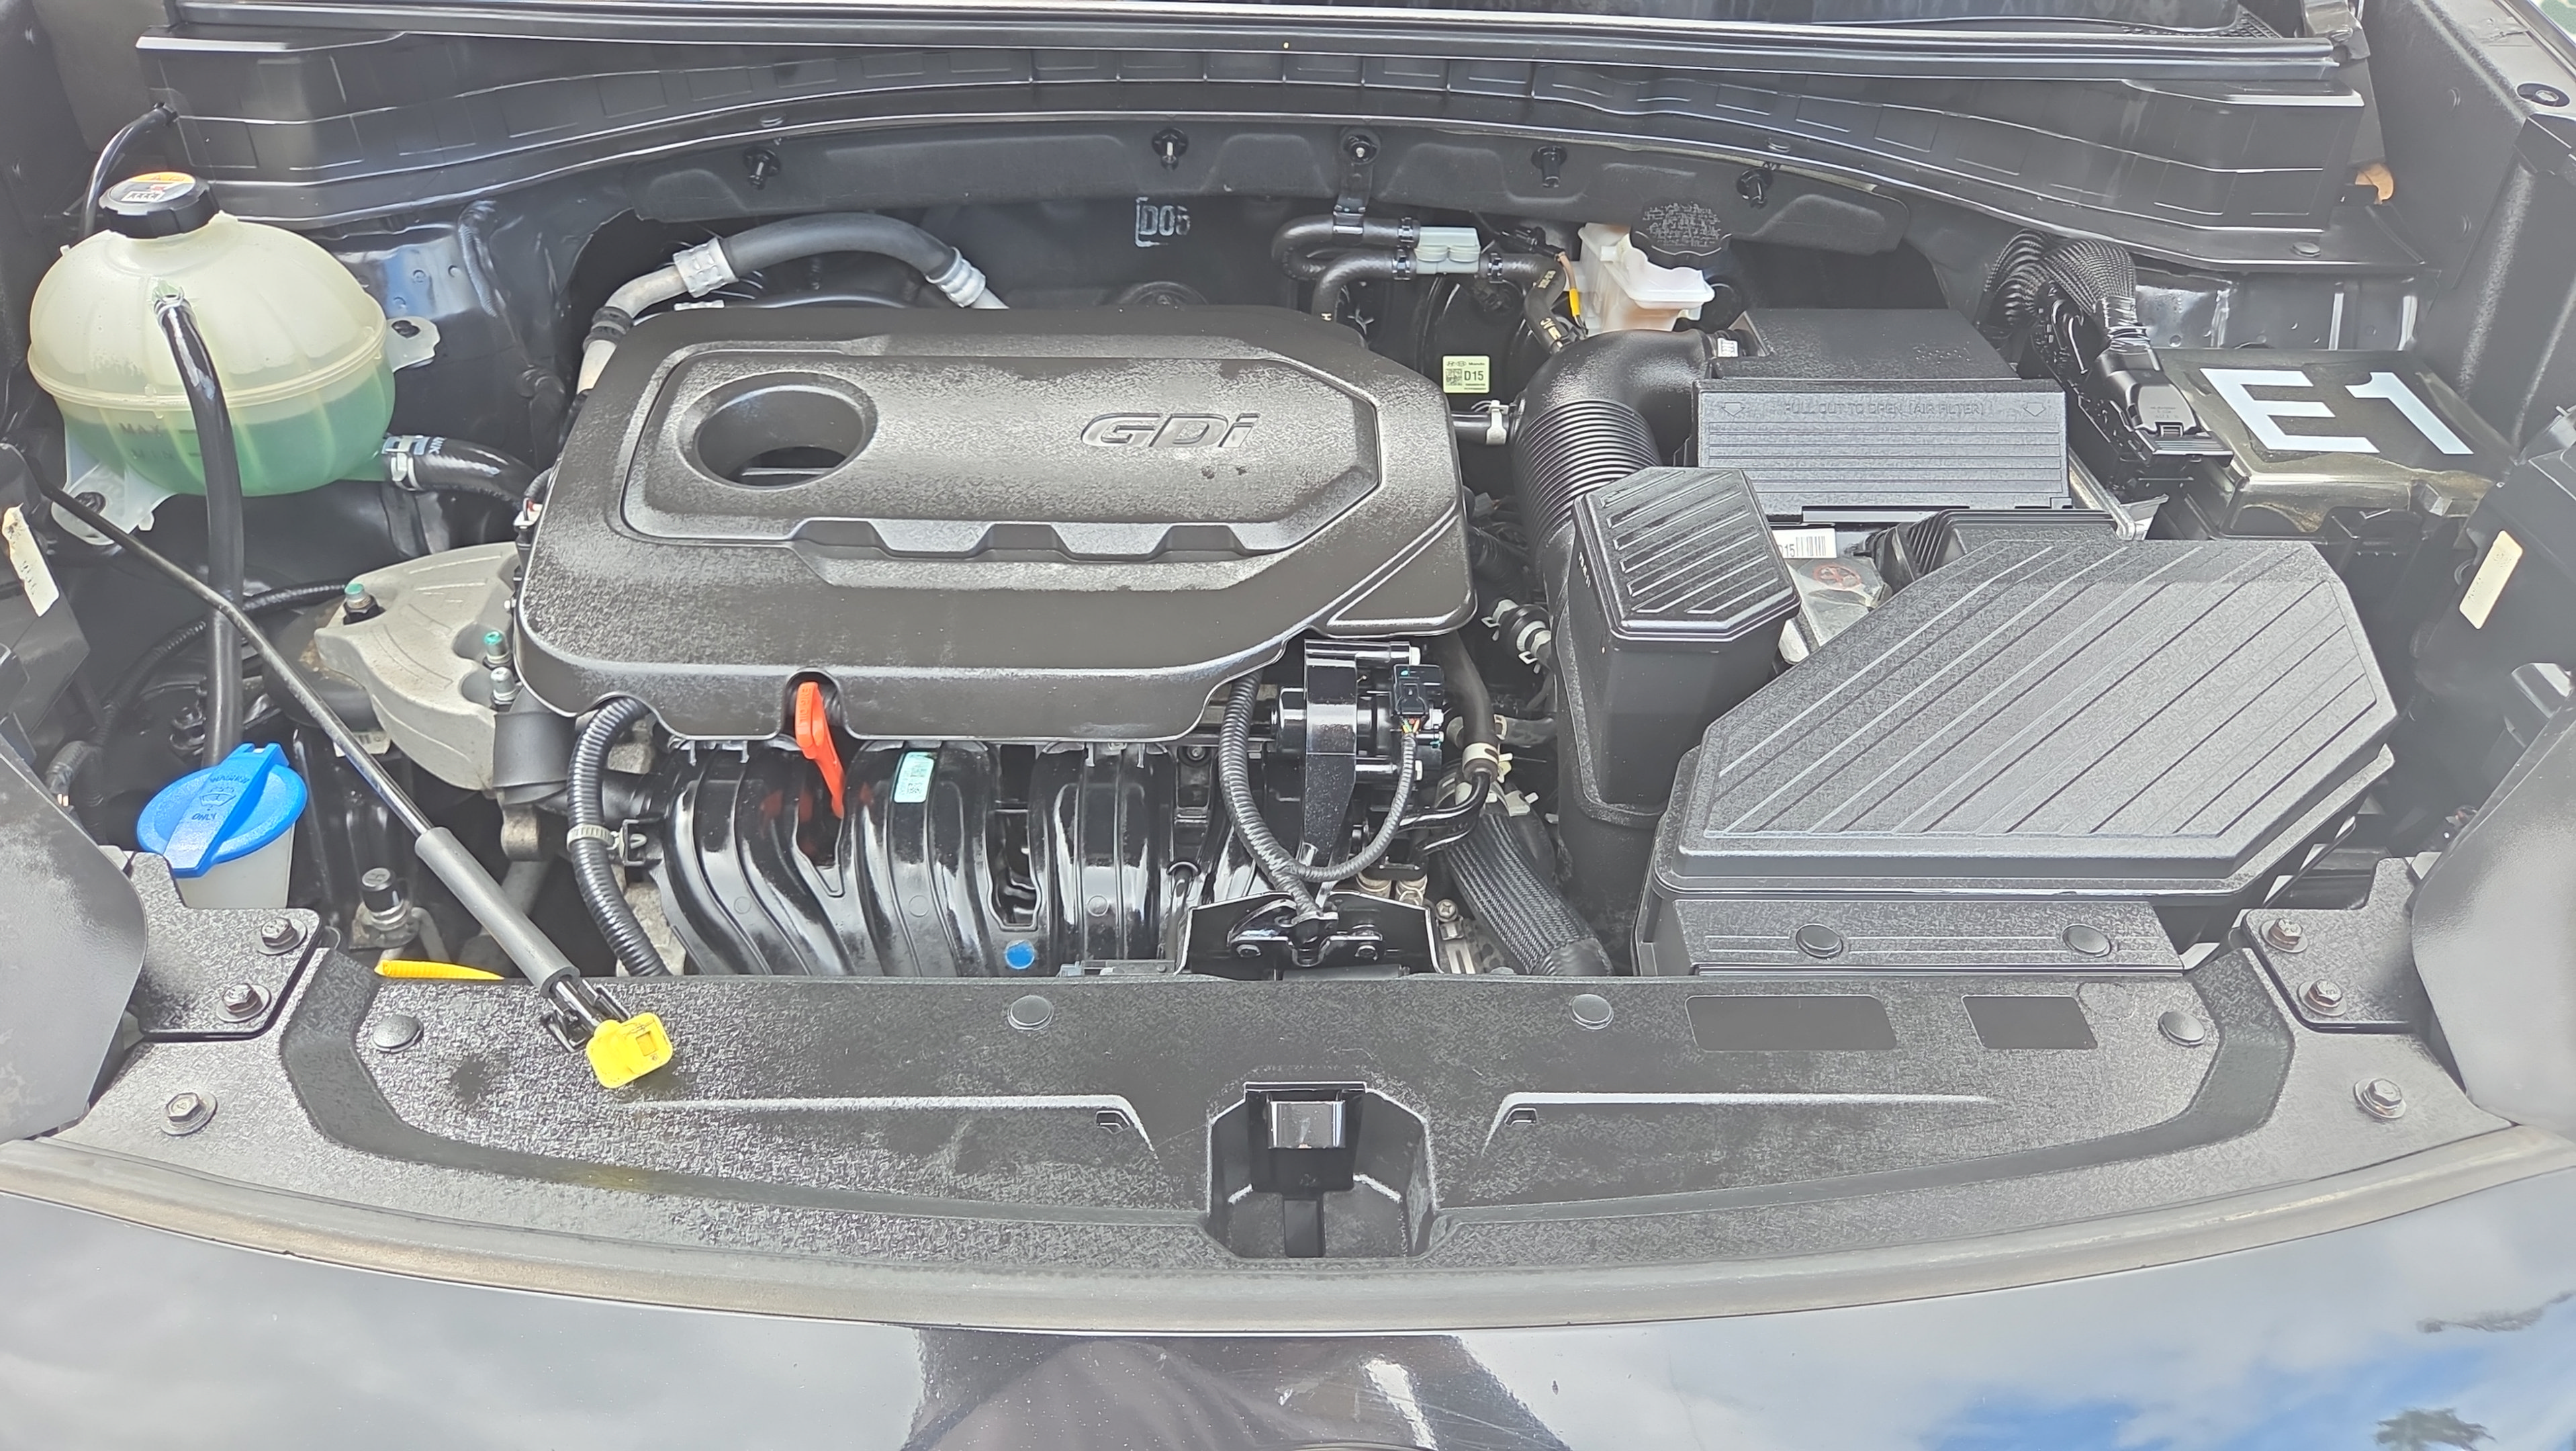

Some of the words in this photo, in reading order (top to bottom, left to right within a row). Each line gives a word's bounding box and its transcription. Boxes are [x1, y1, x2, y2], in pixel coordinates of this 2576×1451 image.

[1464, 370, 1484, 381] D15
[1819, 403, 1843, 414] OUT
[1845, 403, 1864, 414] TO
[1868, 403, 1903, 414] OPEN
[2199, 367, 2475, 455] E1
[119, 423, 161, 435] MAX
[1080, 412, 1261, 447] GDi
[191, 812, 217, 820] ONLY
